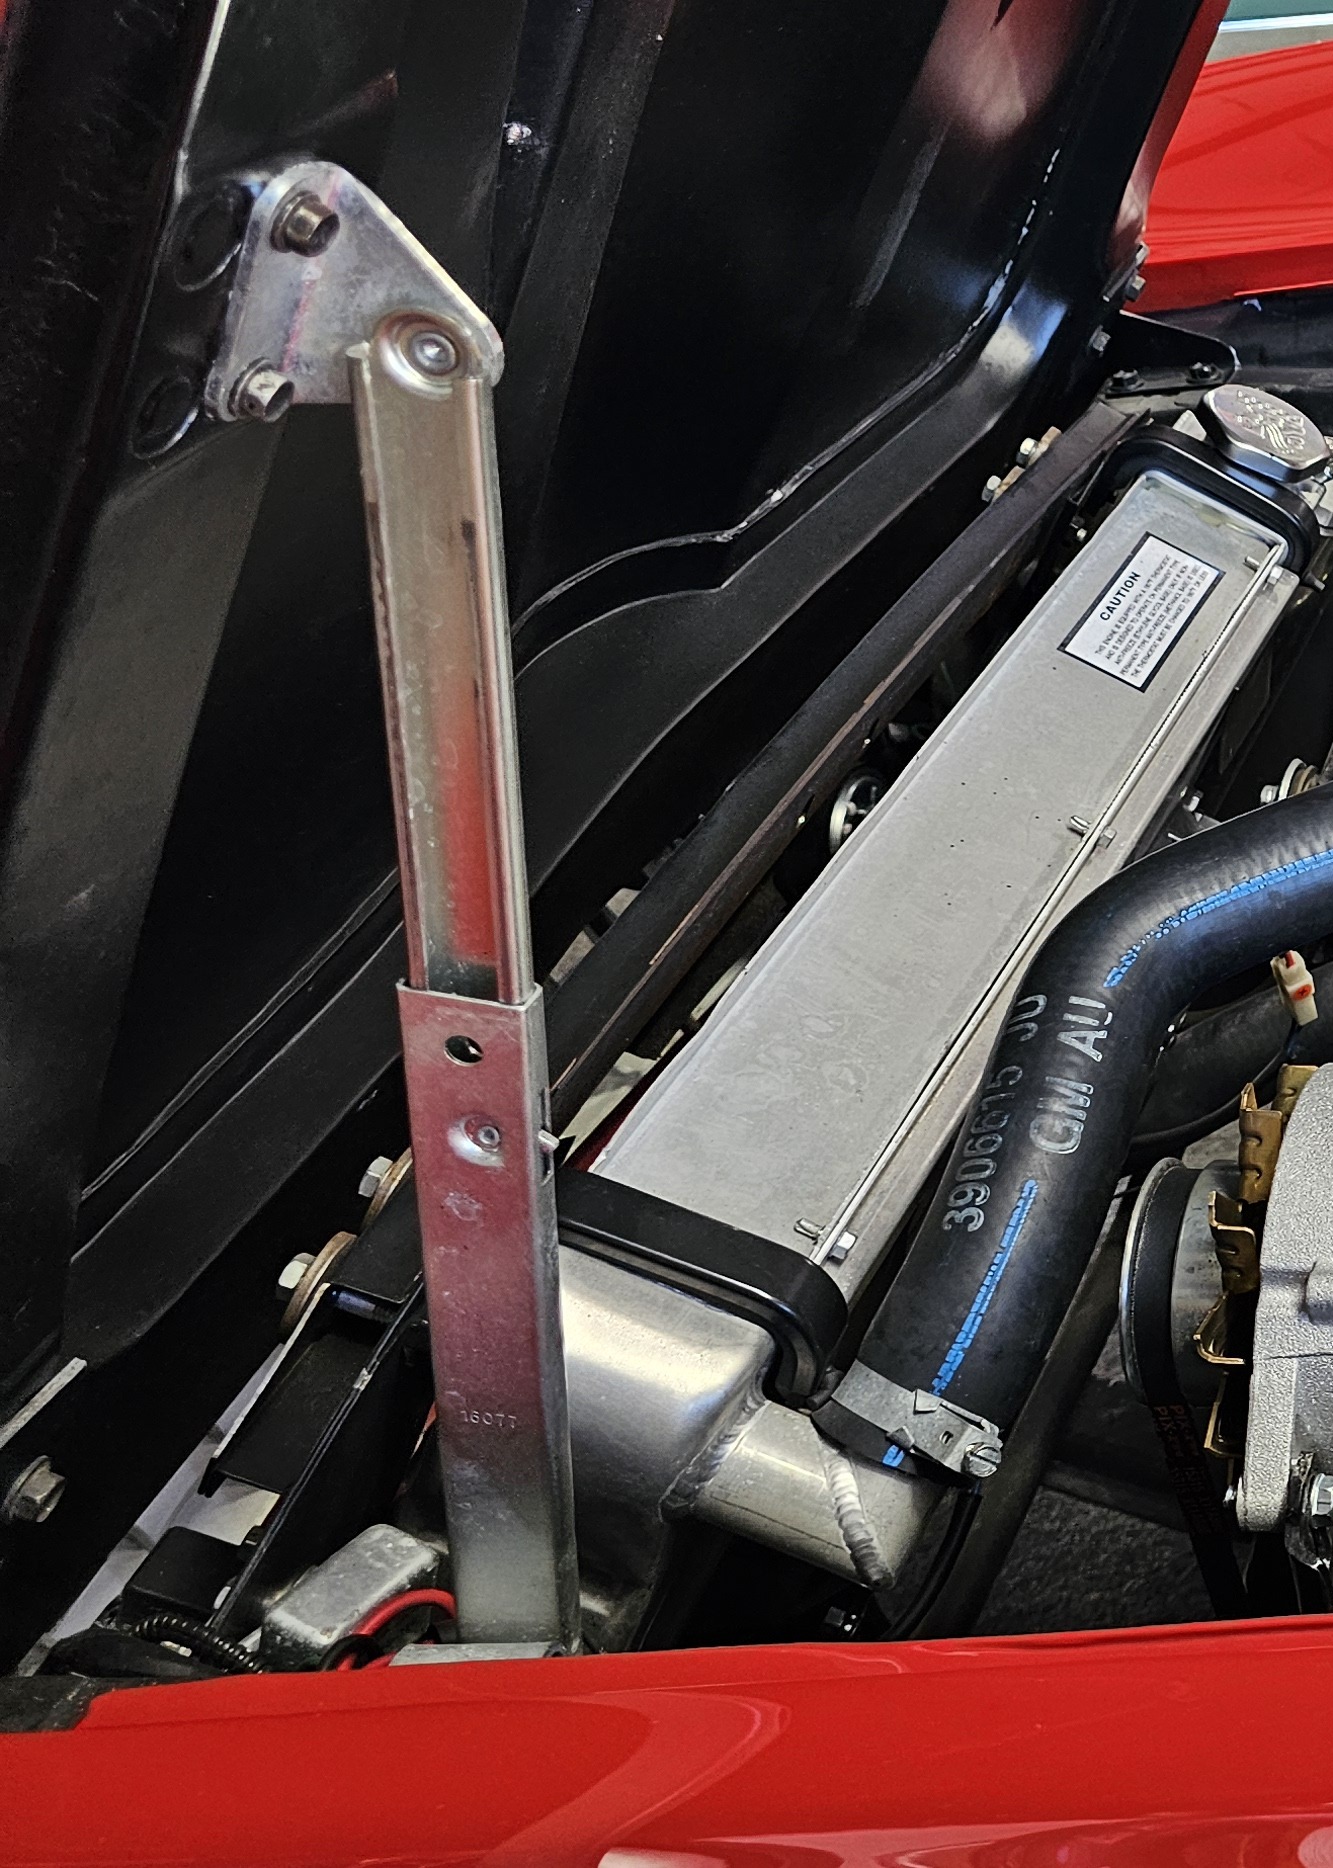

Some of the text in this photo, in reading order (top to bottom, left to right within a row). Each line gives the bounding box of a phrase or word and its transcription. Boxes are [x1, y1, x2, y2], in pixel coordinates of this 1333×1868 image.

[1097, 570, 1141, 621] CAUTION
[943, 1066, 1022, 1232] 3906615
[1029, 1076, 1094, 1154] GM
